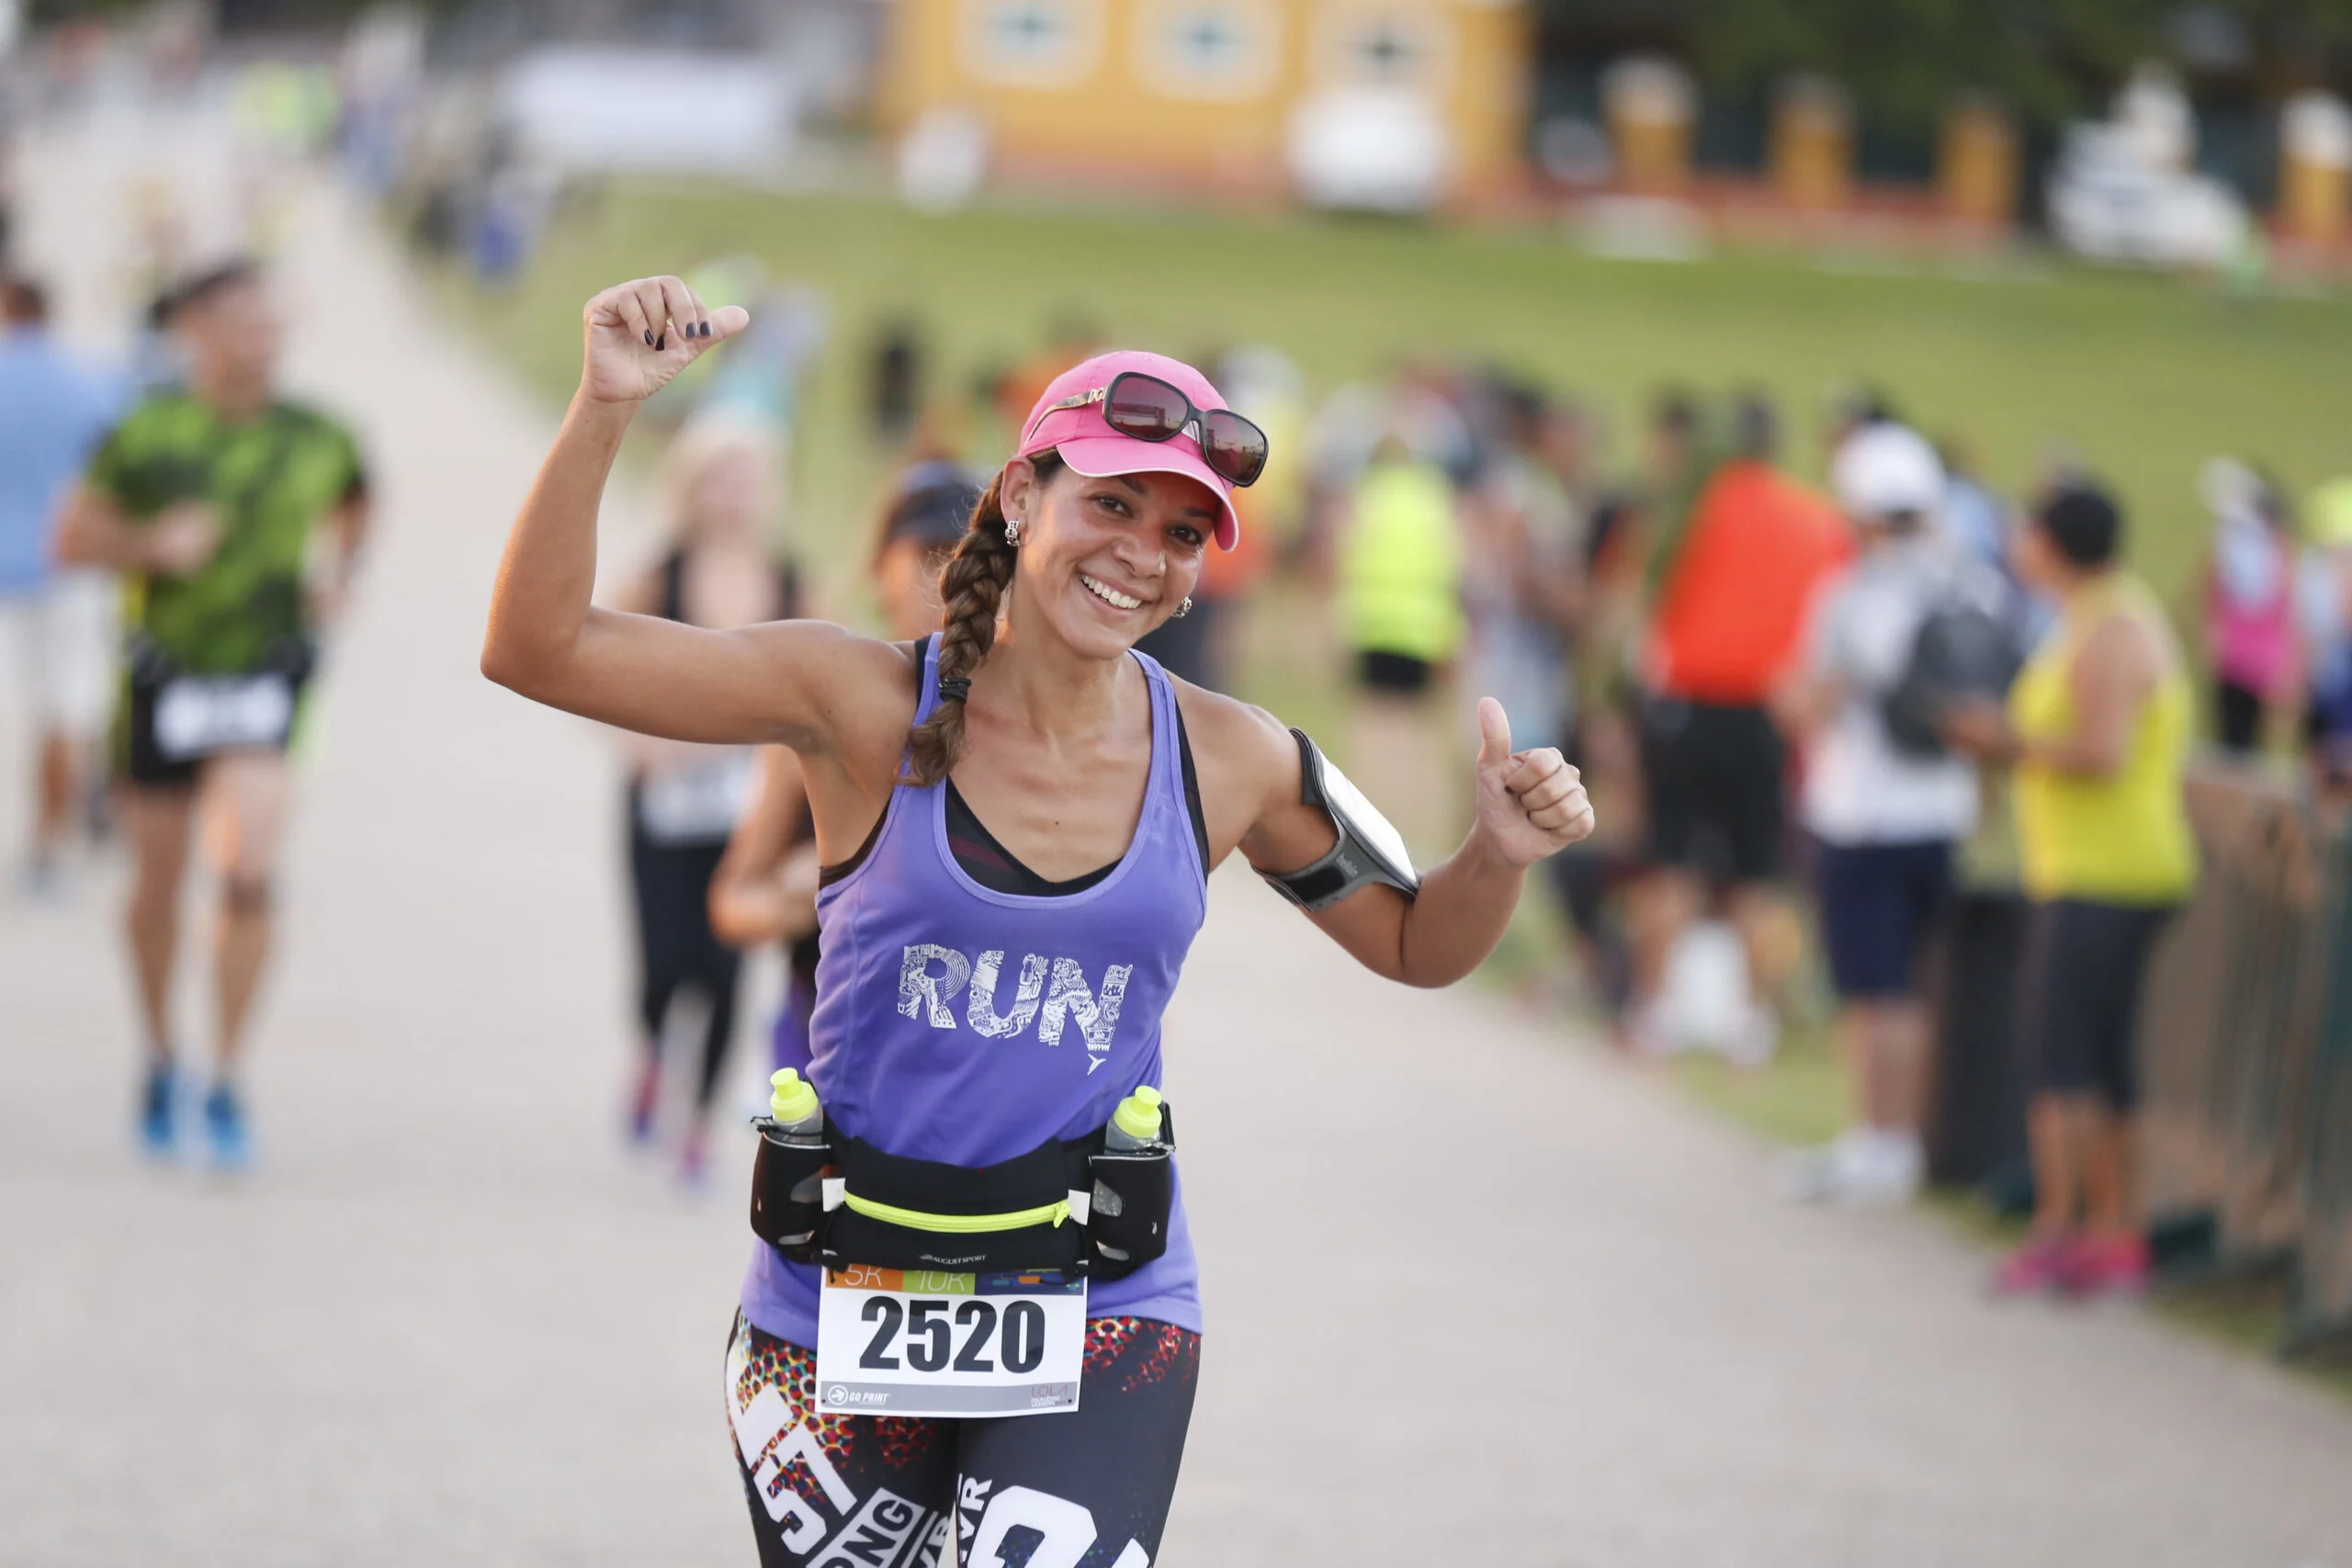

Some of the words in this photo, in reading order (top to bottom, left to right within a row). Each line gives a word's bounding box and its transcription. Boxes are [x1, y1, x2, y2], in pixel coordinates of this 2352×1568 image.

[897, 943, 1133, 1052] RUN
[844, 1263, 882, 1286] 5K
[858, 1295, 1046, 1374] 2520
[849, 1392, 861, 1402] GO
[862, 1393, 888, 1404] PRINT
